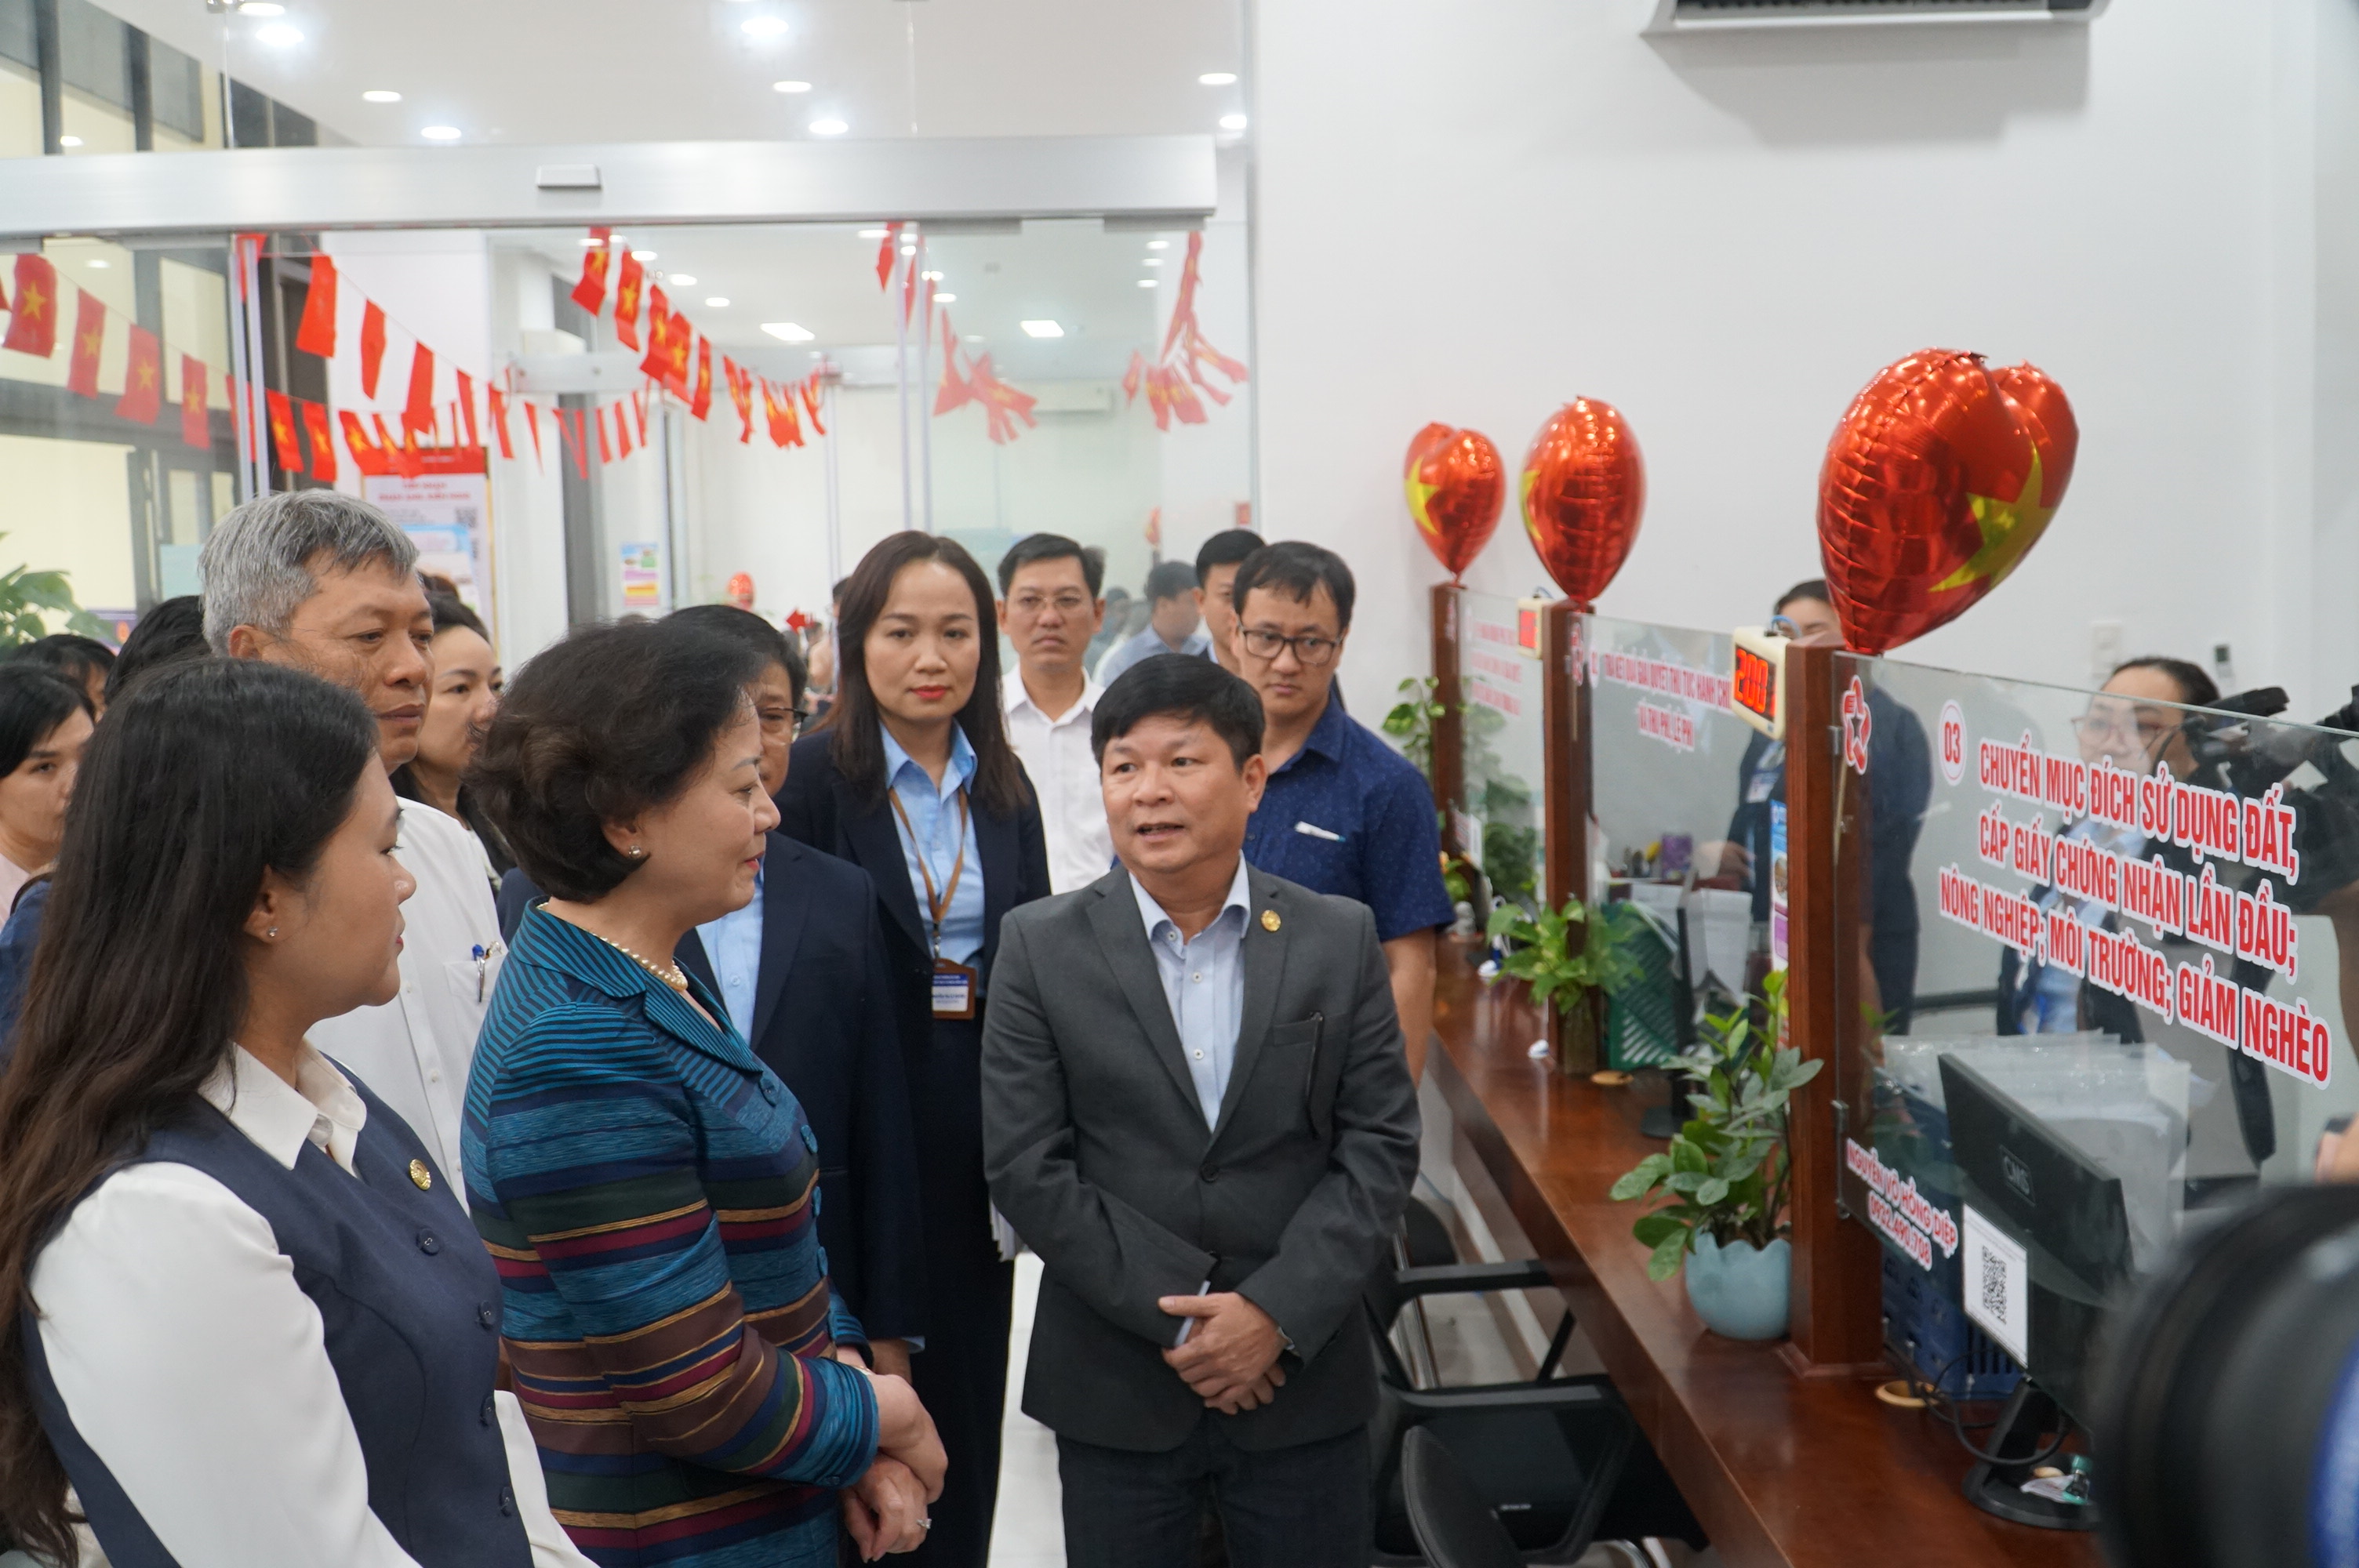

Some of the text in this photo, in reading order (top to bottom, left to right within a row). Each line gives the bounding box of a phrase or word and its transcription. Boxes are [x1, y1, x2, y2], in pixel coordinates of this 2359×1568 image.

[1944, 721, 1961, 764] 03
[1979, 733, 2296, 877] CHUYỂN MỤC ĐÍCH SỬ DỤNG ĐẤT,
[1979, 804, 2296, 977] CẤP GIẤY CHỨNG NHẬN LẦN ĐẦU;
[1940, 868, 2329, 1082] NÔNG NGHIỆP; MÔI TRƯỜNG; GIẢM NGHÈO
